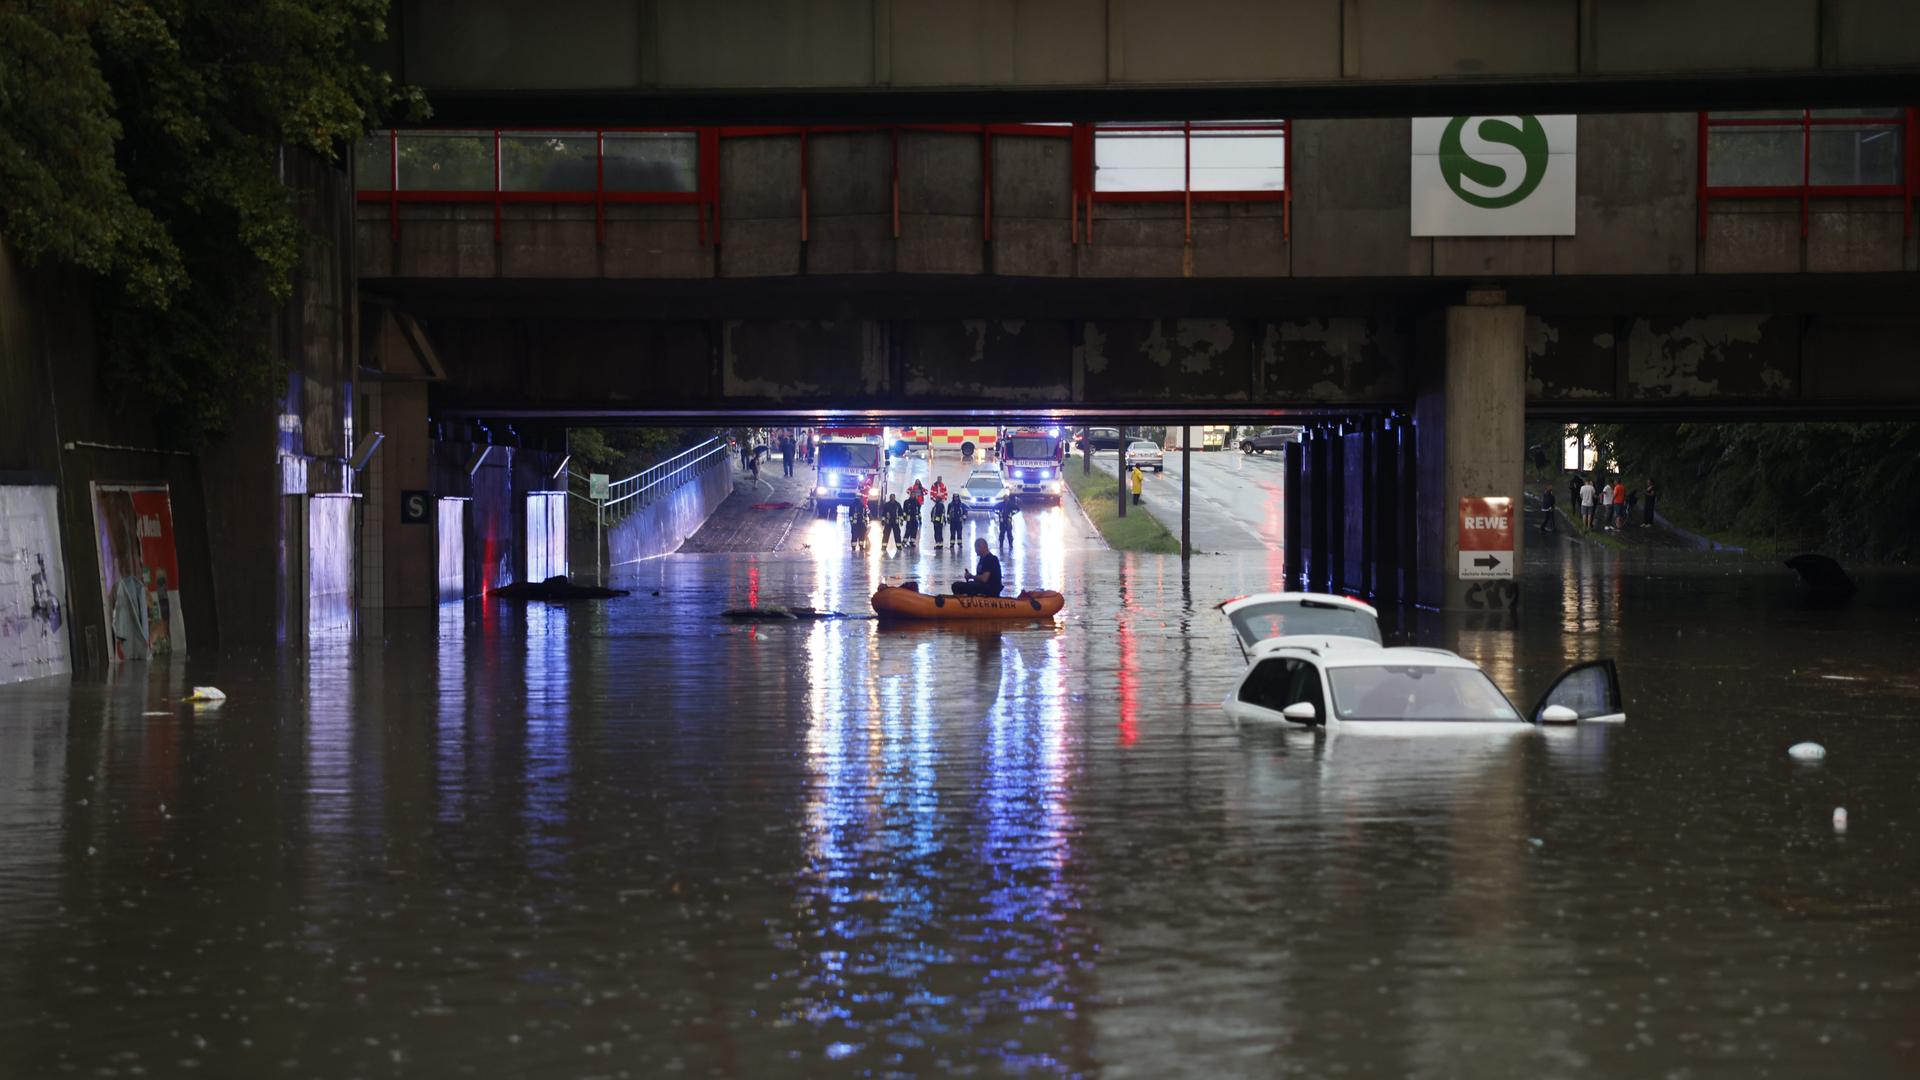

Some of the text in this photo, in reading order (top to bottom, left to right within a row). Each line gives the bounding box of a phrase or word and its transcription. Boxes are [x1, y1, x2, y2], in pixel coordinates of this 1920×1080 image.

[1459, 115, 1527, 198] S
[409, 496, 423, 517] S
[1464, 516, 1509, 529] REWE
